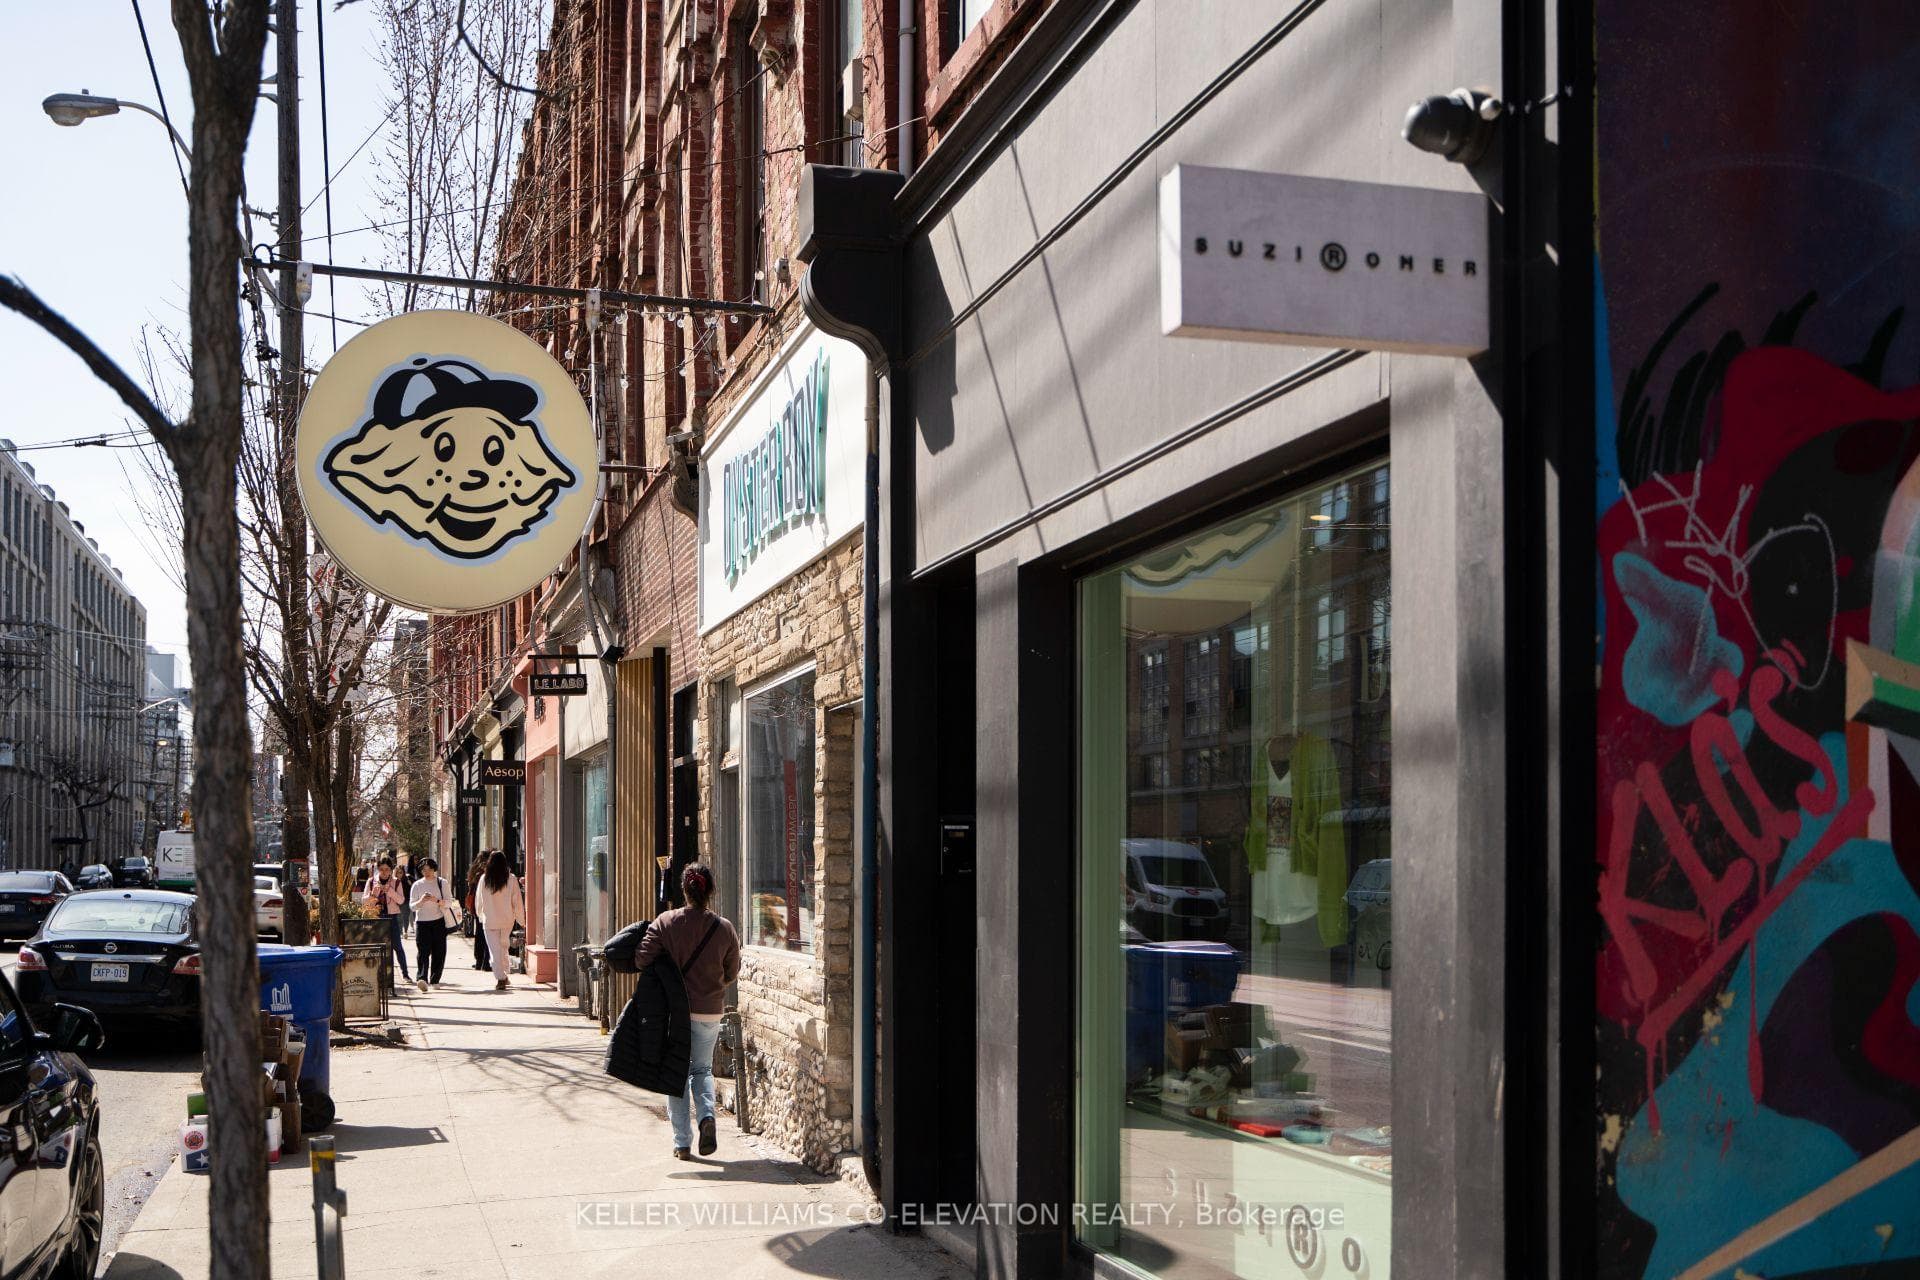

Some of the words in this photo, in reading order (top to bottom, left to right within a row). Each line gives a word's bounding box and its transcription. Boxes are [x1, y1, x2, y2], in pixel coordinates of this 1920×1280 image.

[723, 421, 783, 582] OYSTER
[783, 347, 825, 521] BOY
[534, 678, 550, 689] LE
[552, 677, 585, 689] LABO
